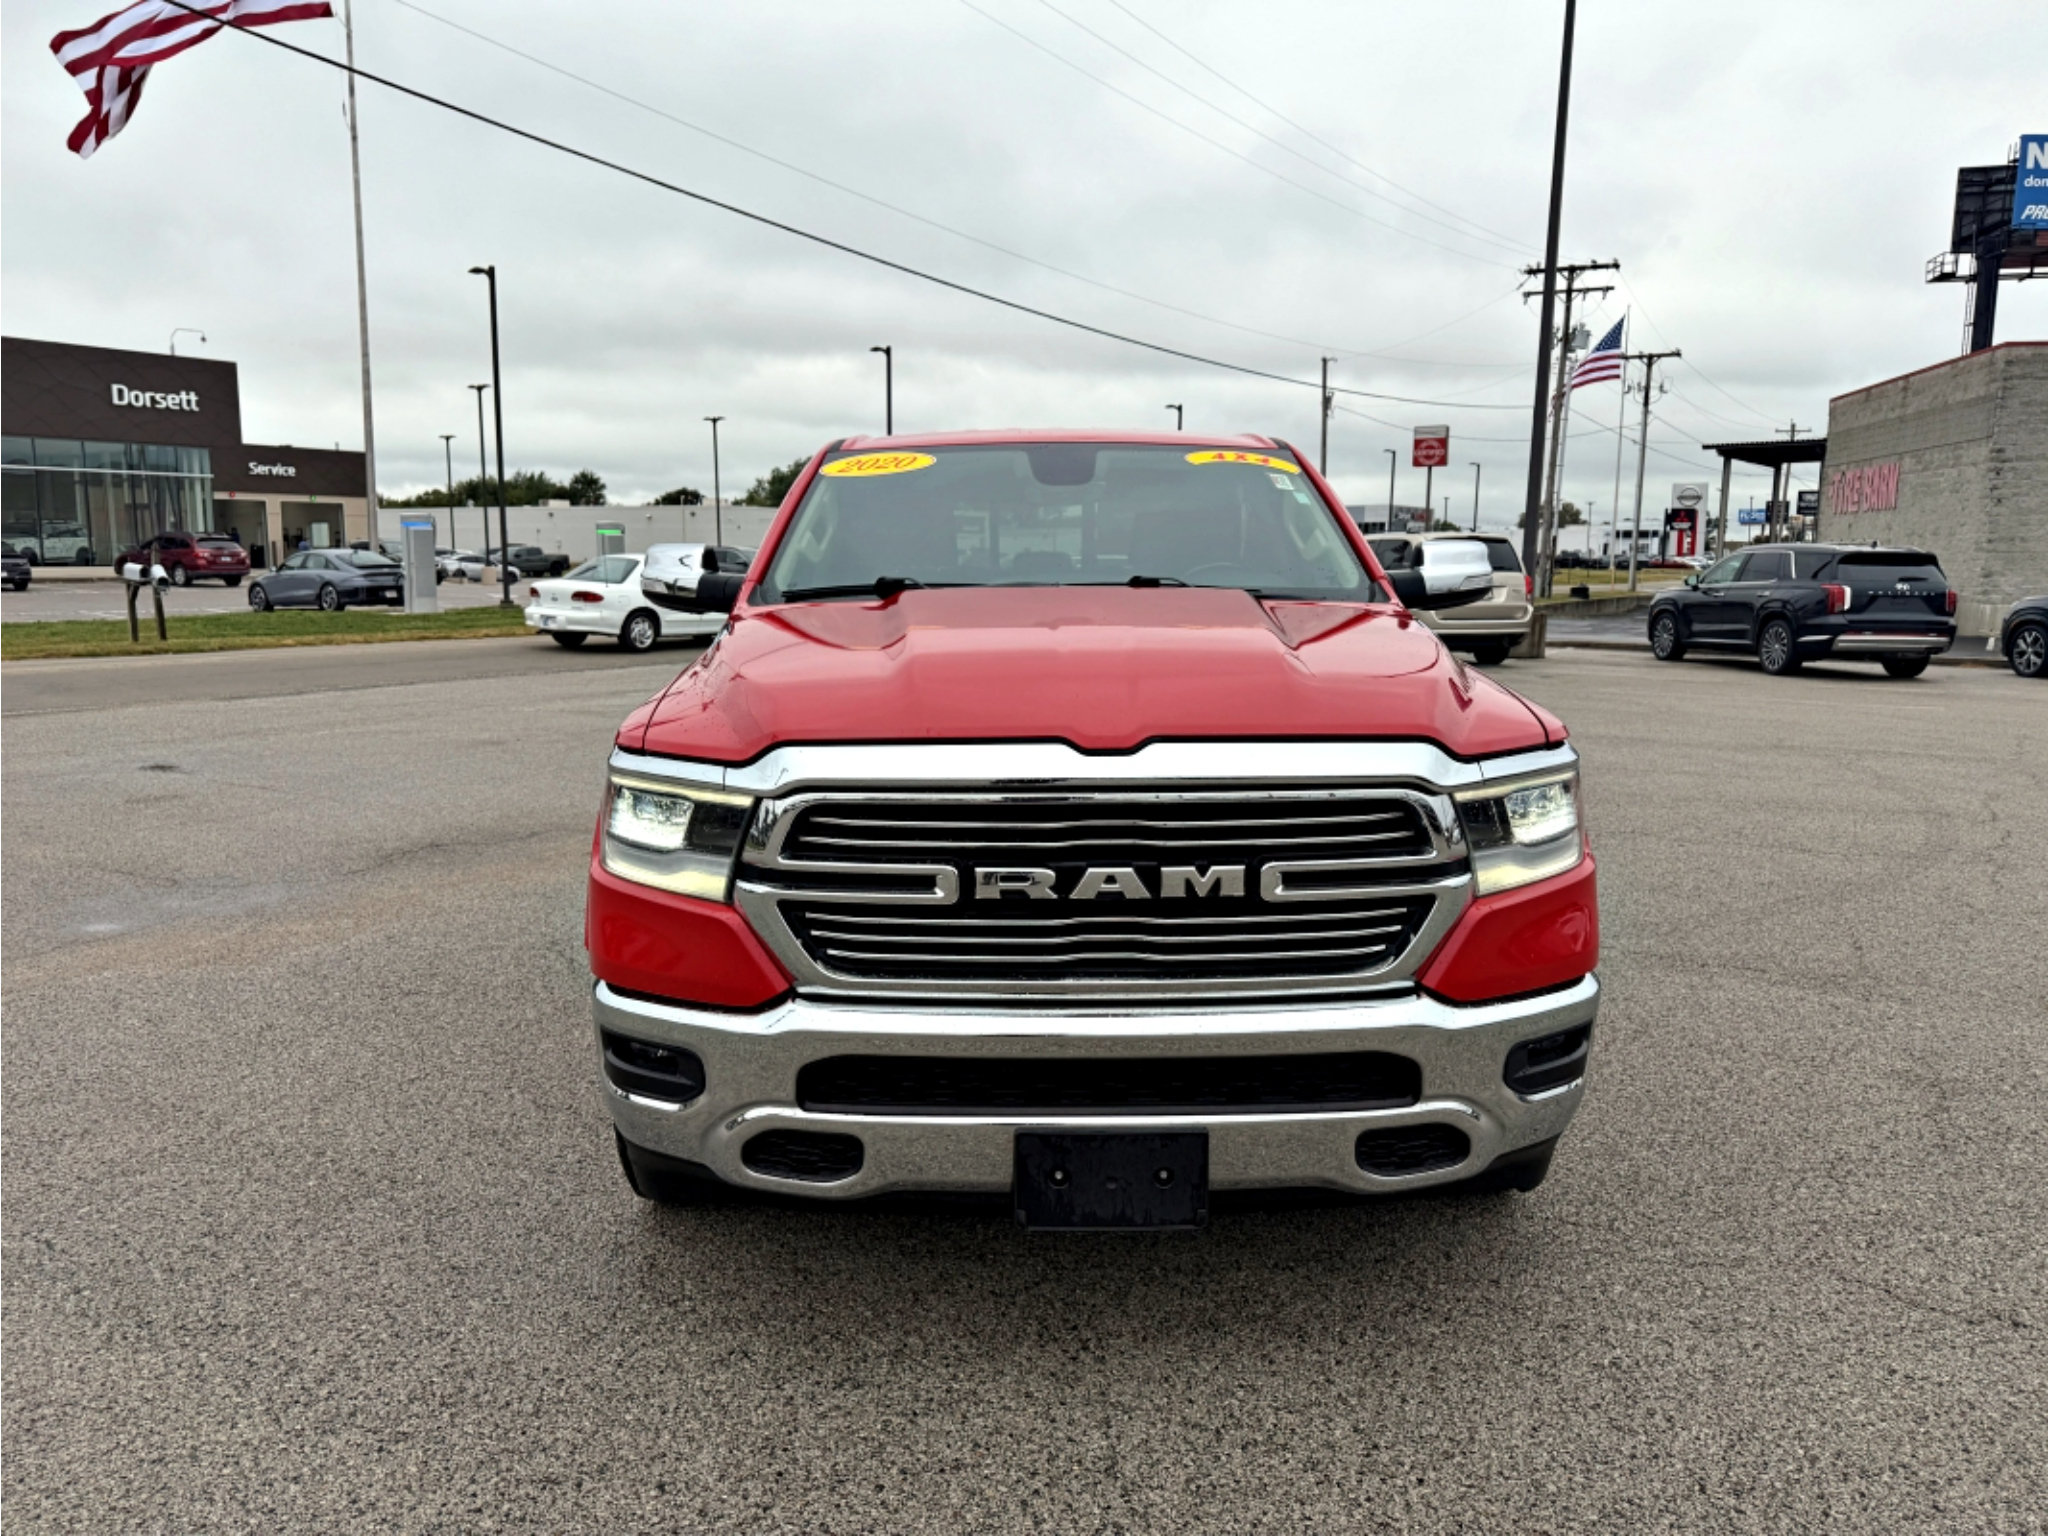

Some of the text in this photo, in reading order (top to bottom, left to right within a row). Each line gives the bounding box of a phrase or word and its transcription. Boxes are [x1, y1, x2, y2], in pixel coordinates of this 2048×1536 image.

[111, 384, 200, 412] Dorsett
[248, 462, 296, 477] Service
[836, 455, 918, 473] 2020
[1830, 463, 1900, 515] TIRE BARN
[974, 865, 1247, 900] RAM
